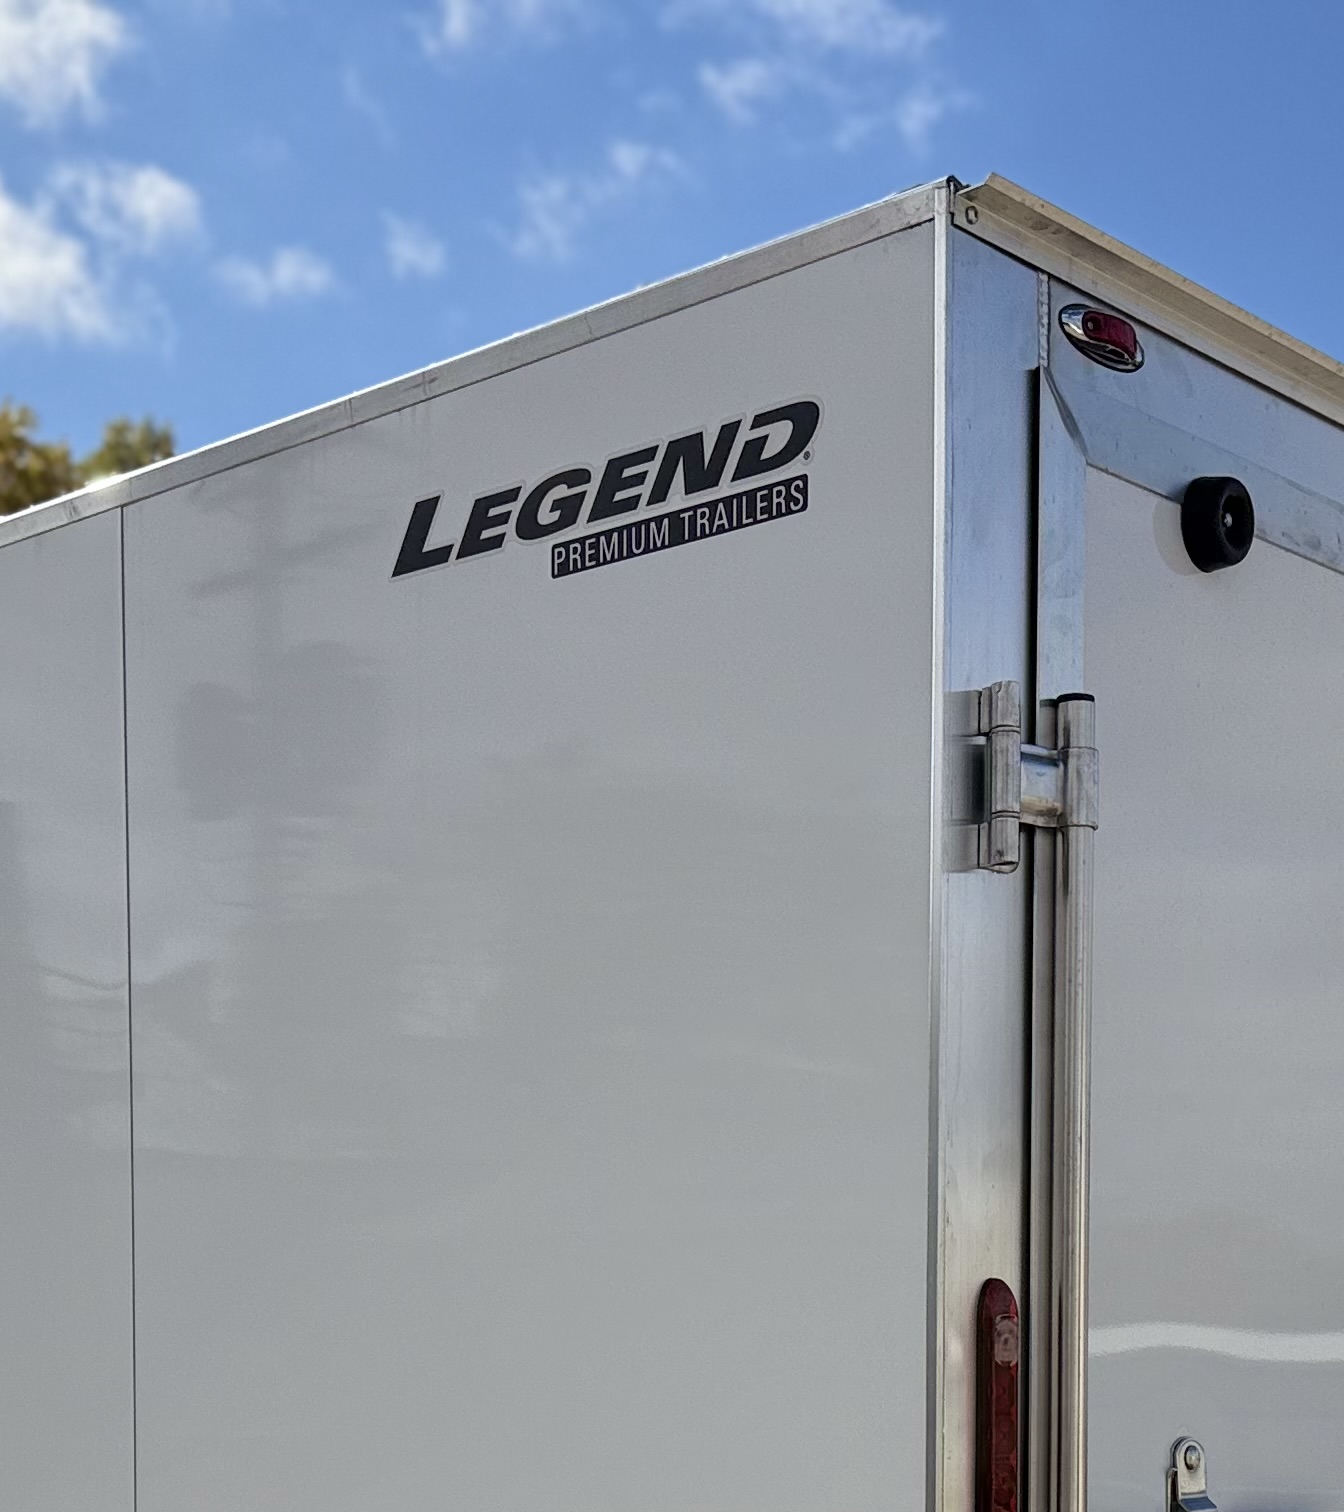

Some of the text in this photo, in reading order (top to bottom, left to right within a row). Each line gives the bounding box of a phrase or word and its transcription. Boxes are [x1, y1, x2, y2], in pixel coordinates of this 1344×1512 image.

[392, 401, 820, 577] LEGEND
[554, 480, 804, 576] PREMIUM TRAILERS
